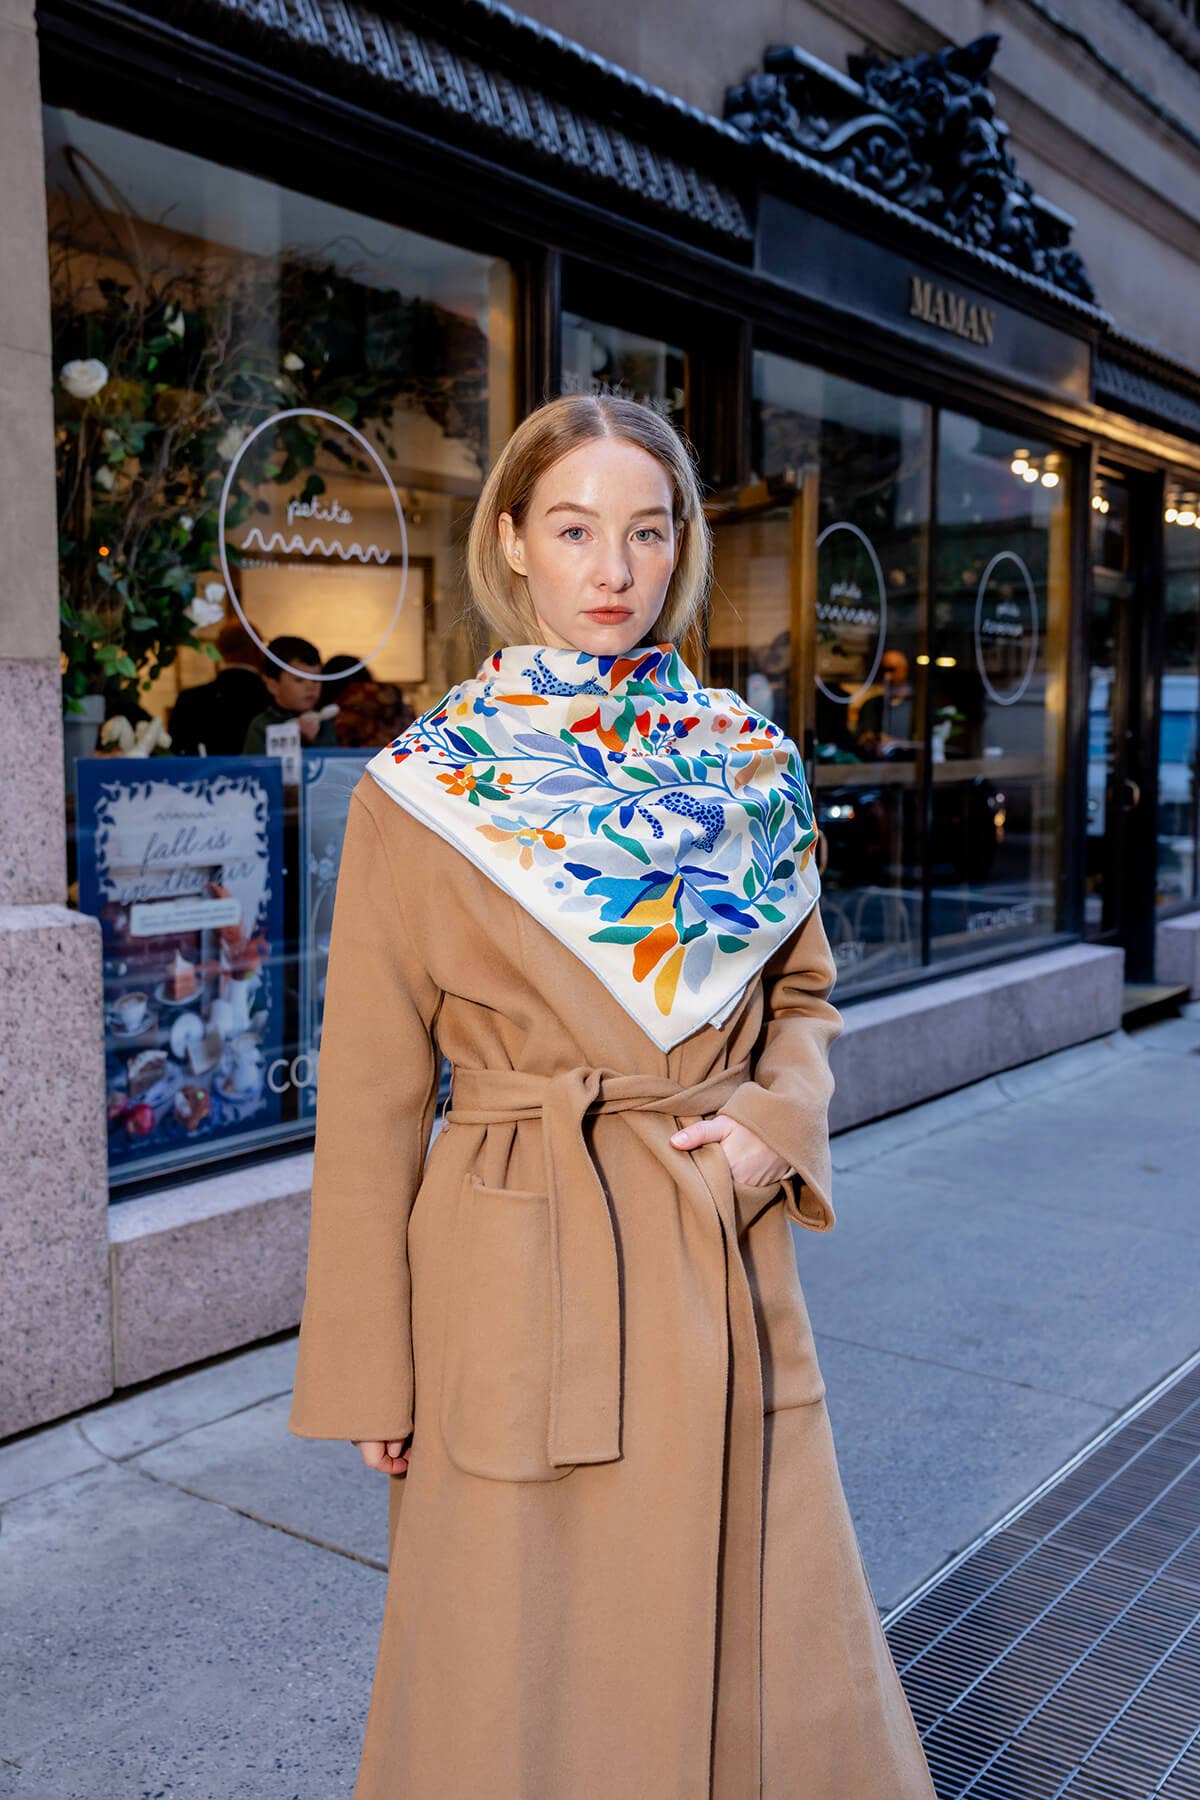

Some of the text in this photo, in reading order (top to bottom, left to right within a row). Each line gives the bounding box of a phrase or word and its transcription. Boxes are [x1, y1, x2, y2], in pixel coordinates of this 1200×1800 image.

[911, 277, 993, 346] MAMAN
[288, 496, 352, 525] petite
[139, 825, 231, 877] fall is
